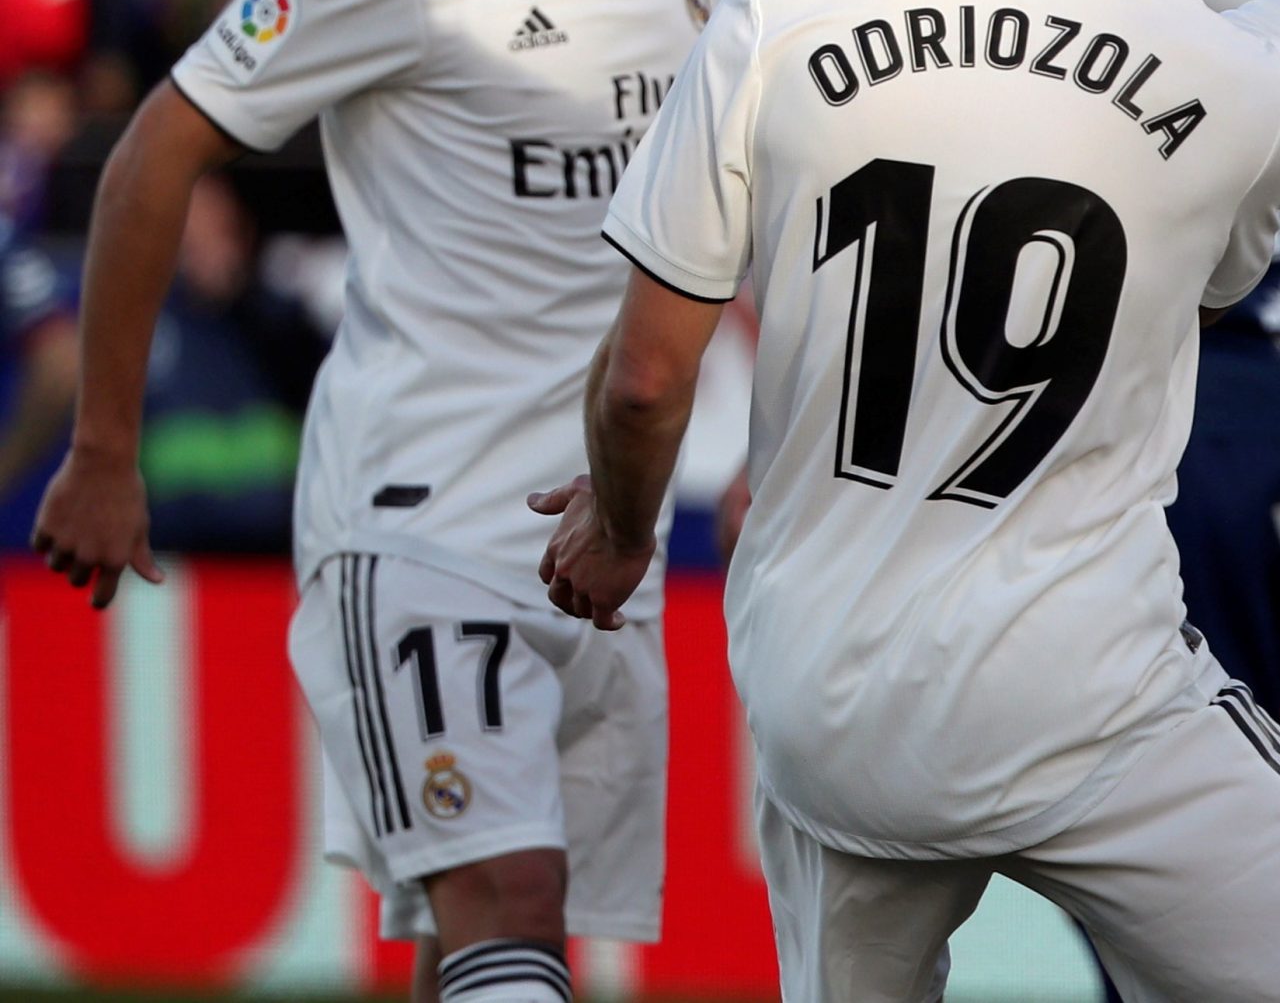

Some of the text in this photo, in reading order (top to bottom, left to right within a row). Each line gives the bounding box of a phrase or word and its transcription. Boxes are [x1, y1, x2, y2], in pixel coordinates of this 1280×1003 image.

[808, 6, 1207, 160] ODRIOZOLA
[812, 158, 1127, 510] 19
[391, 621, 511, 741] 17
